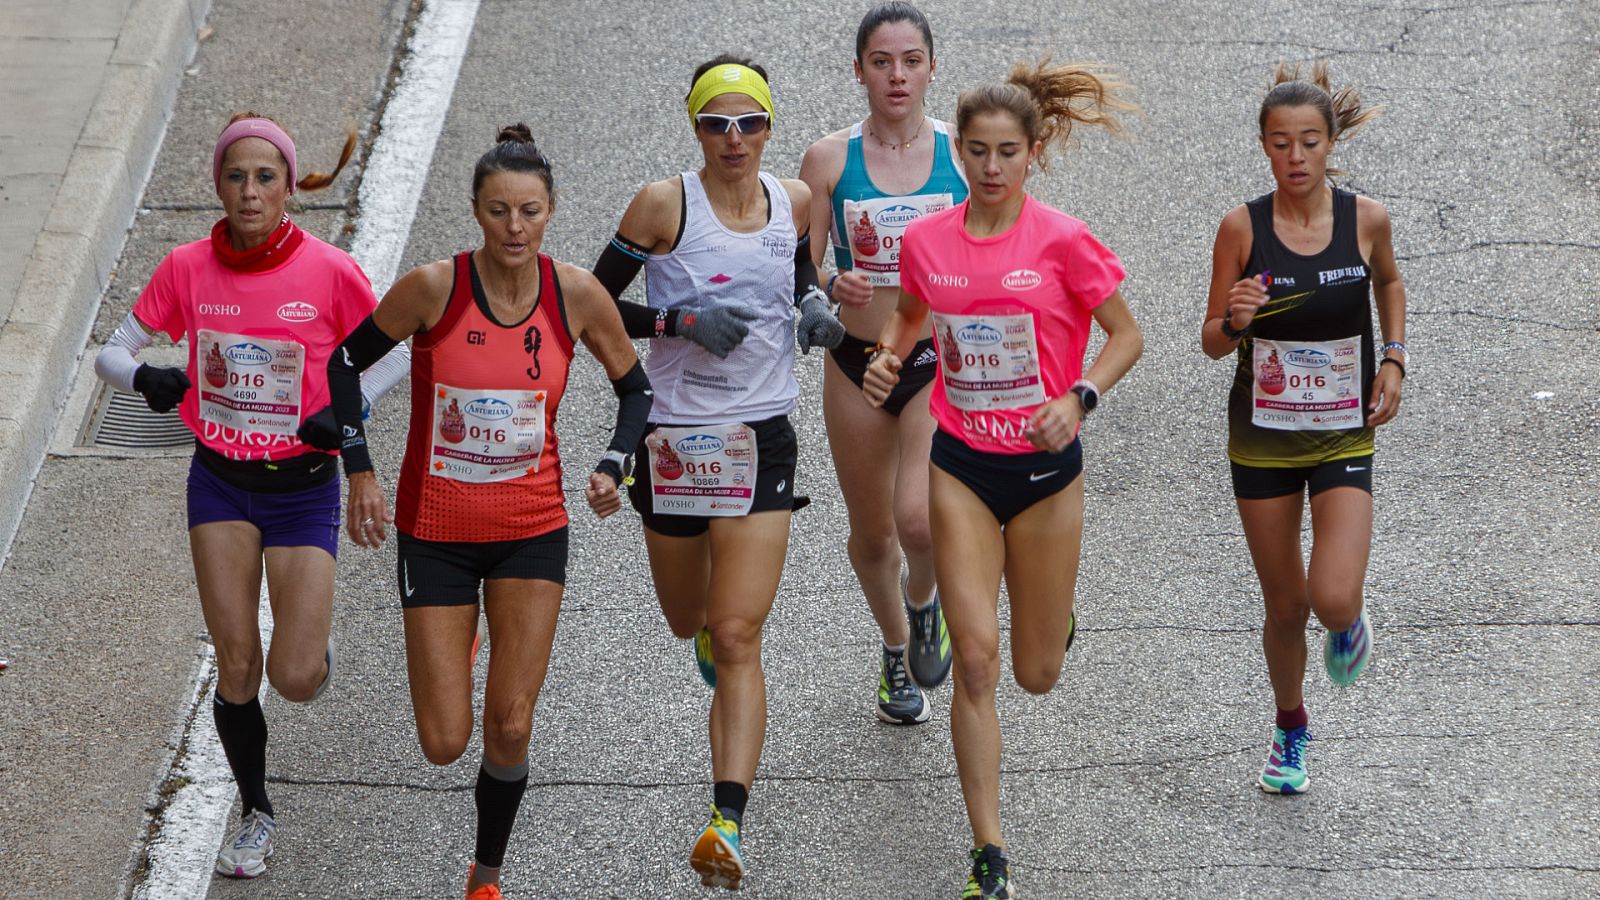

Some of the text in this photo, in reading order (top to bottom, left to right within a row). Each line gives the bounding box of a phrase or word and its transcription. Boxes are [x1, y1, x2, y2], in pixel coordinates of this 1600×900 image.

[882, 235, 905, 249] 01
[862, 263, 889, 271] CARRERA
[1345, 265, 1366, 278] TEAM
[866, 274, 890, 285] YSHO
[928, 272, 968, 288] OYSHO
[1005, 276, 1039, 287] ASTURIANA
[199, 303, 241, 317] OYSHO
[280, 308, 315, 318] ASTURIANA
[961, 331, 998, 341] ASTURIANA
[229, 349, 269, 362] ASTURIANA
[1288, 353, 1327, 364] ASTURIANA
[1334, 349, 1355, 358] SUMA
[913, 355, 938, 368] adida
[964, 353, 1000, 368] 016
[229, 371, 265, 388] 016
[981, 370, 987, 379] 5
[992, 381, 1014, 389] MUJER
[1289, 374, 1326, 388] 016
[233, 390, 257, 400] 4690
[1001, 391, 1034, 401] Santander
[1301, 391, 1314, 401] 45
[251, 403, 273, 412] MUJER
[469, 404, 509, 416] ASTURIANA
[1265, 401, 1294, 410] CARRERA
[1314, 402, 1337, 410] MUJER
[208, 406, 291, 428] OYSHO Santander
[1263, 413, 1296, 423] OYSHO
[962, 410, 1035, 439] SUMA
[469, 426, 506, 443] 016
[483, 445, 490, 454] 2
[681, 442, 721, 451] ASTURIANA
[444, 449, 472, 460] CARRERA
[473, 455, 483, 463] DE
[498, 462, 531, 474] Santander
[685, 461, 721, 475] 016
[691, 477, 720, 486] 10869
[662, 499, 744, 510] OYSHO Santander
